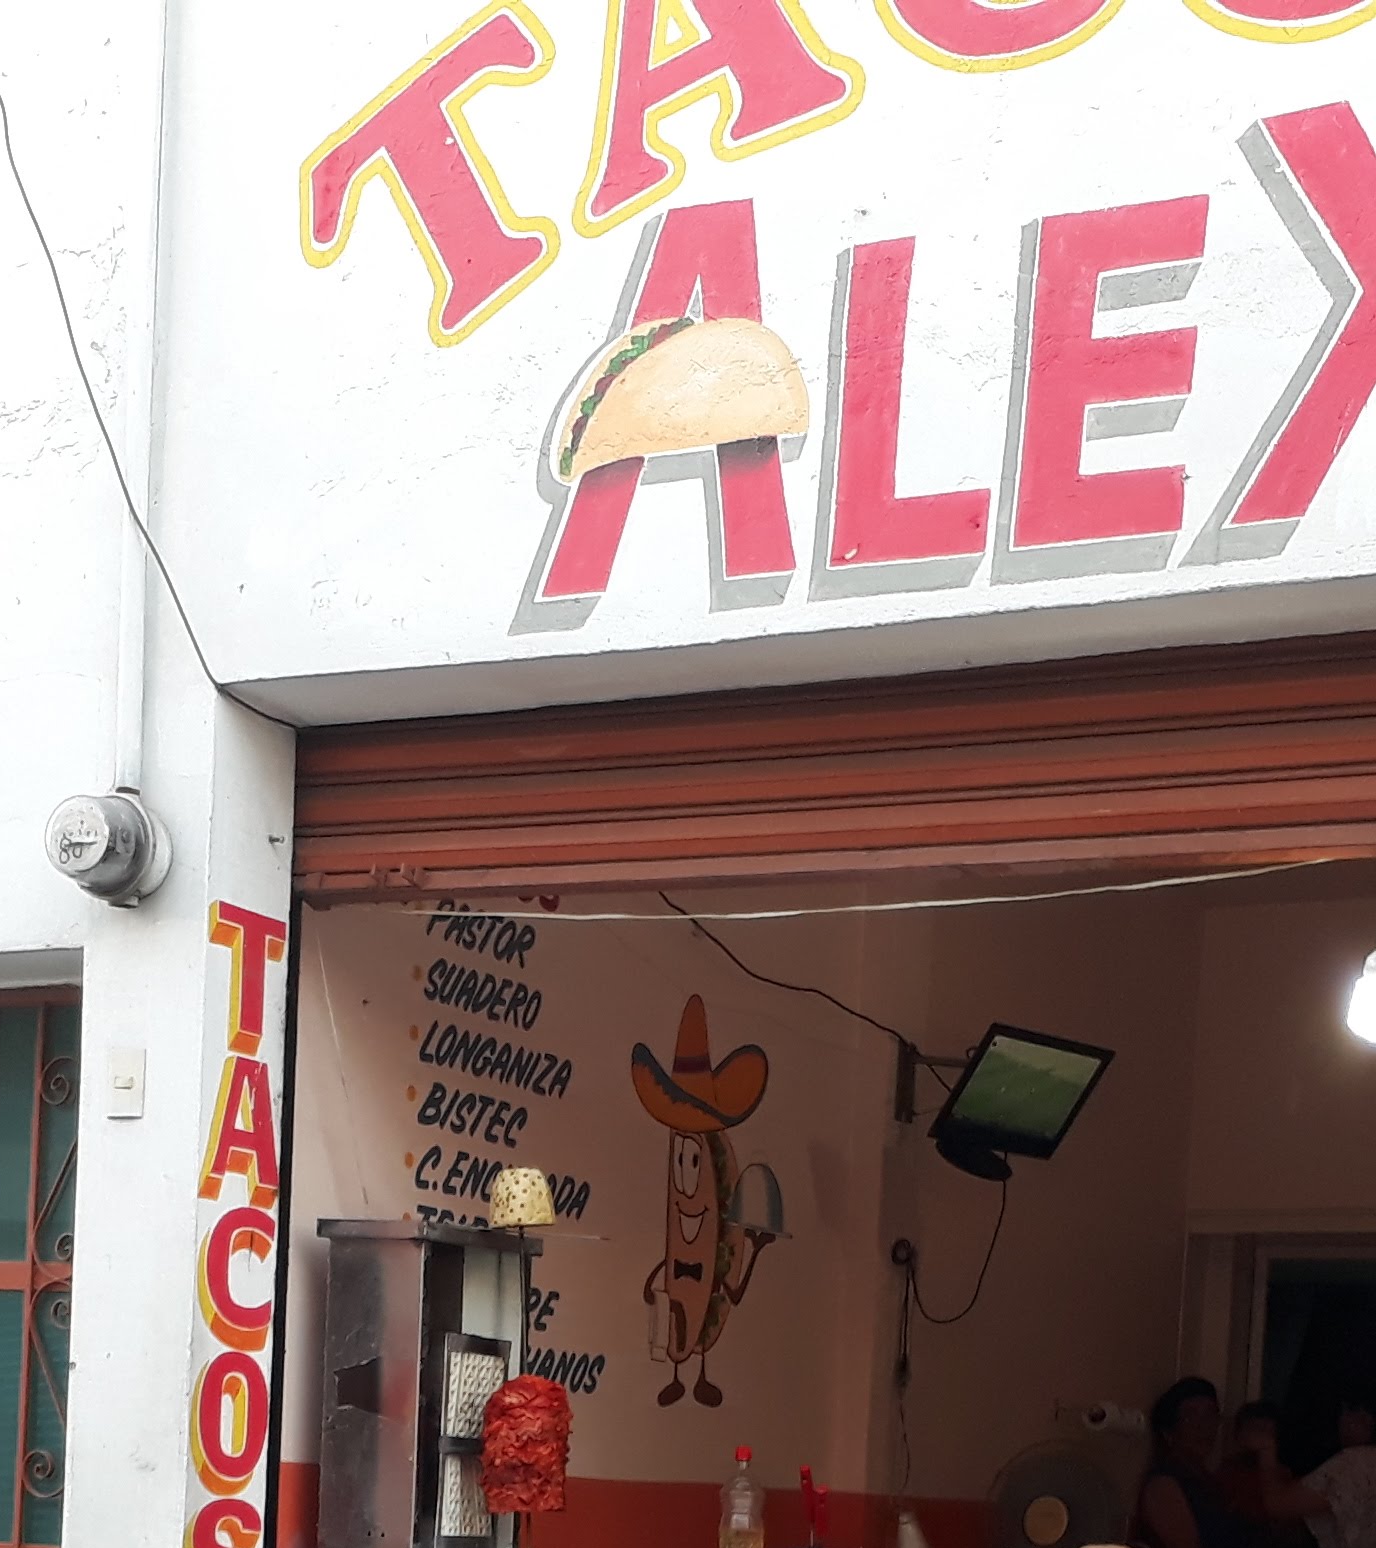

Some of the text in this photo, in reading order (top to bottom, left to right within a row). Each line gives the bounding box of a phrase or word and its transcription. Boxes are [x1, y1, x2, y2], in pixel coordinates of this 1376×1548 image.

[426, 898, 536, 969] PASTOR
[424, 957, 542, 1031] SUADERO
[418, 1020, 572, 1099] LONGANIZA
[416, 1082, 528, 1149] BISTEC
